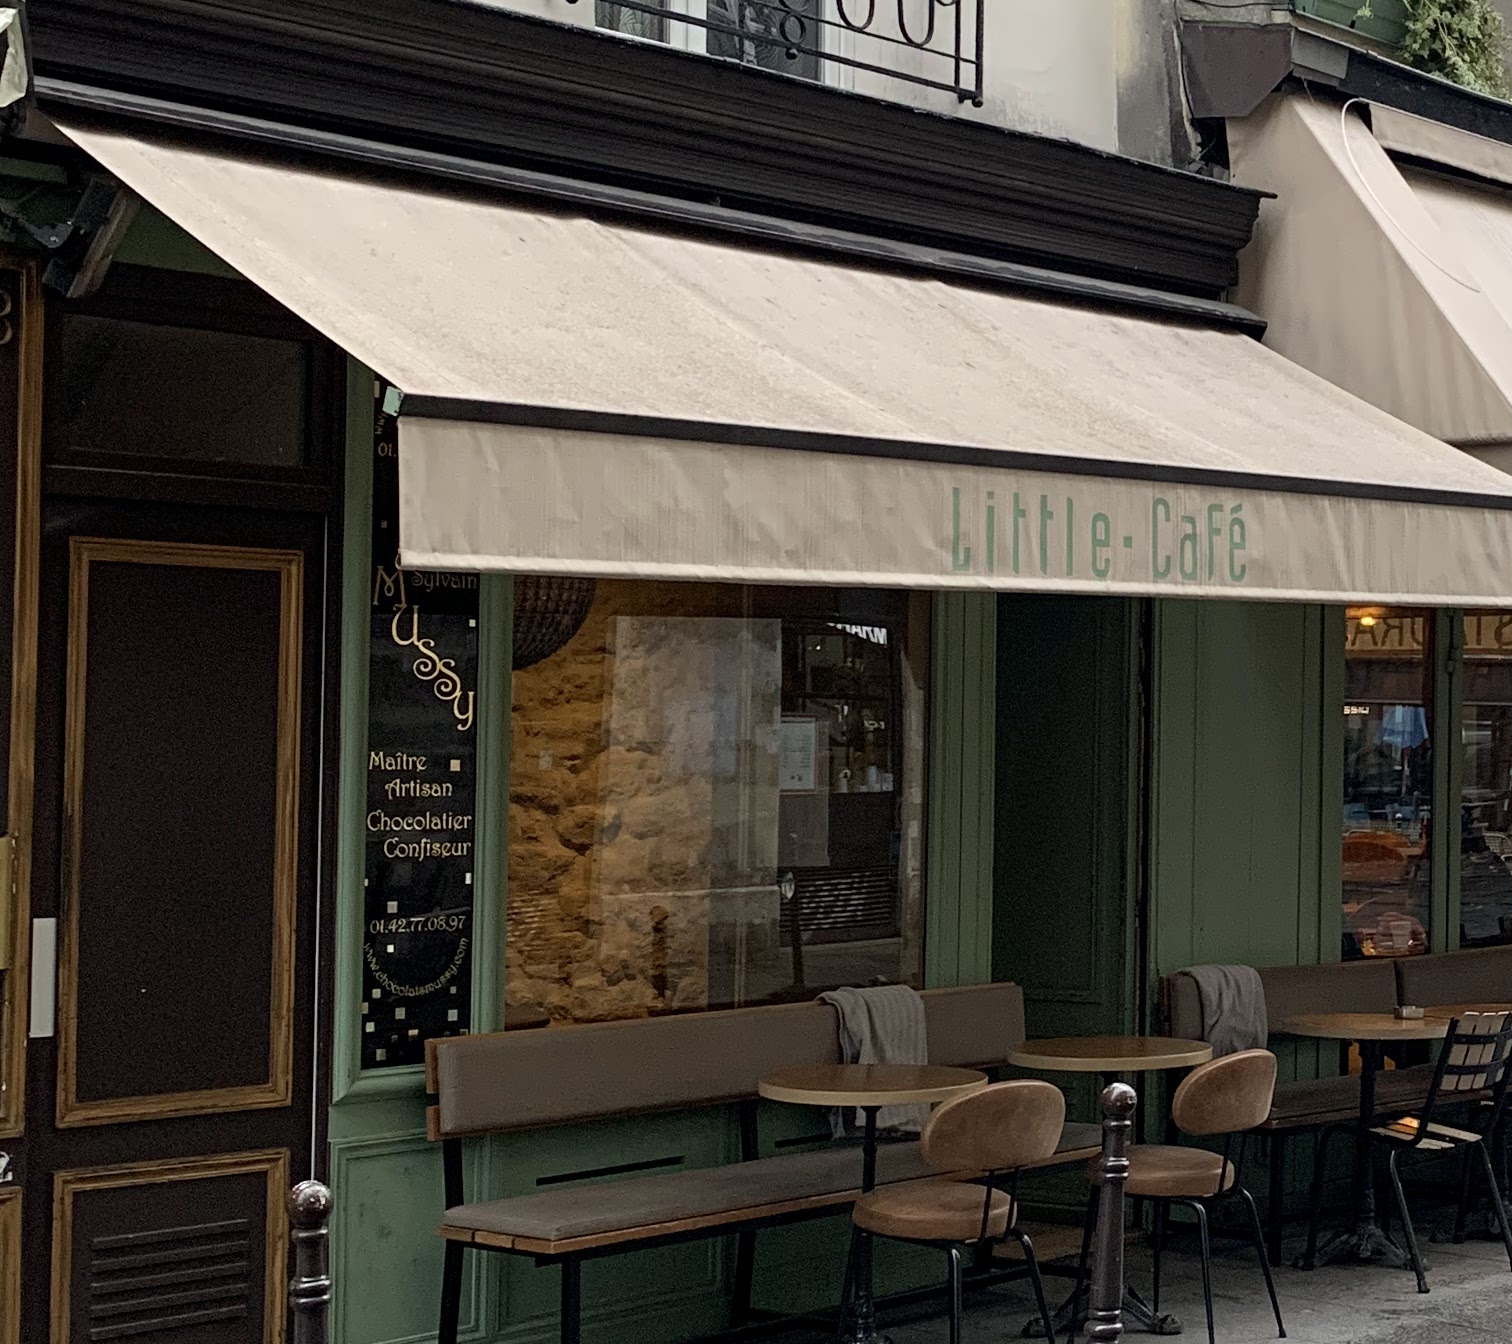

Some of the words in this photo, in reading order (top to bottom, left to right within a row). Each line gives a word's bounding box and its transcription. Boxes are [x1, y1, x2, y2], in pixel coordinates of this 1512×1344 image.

[951, 487, 1111, 578] Little
[1152, 497, 1248, 583] Café
[368, 751, 427, 773] Maître
[385, 778, 453, 800] Artisan
[367, 809, 473, 831] Chocolatier
[383, 837, 472, 862] Confiseur
[370, 915, 466, 934] 01.42.77.08.97
